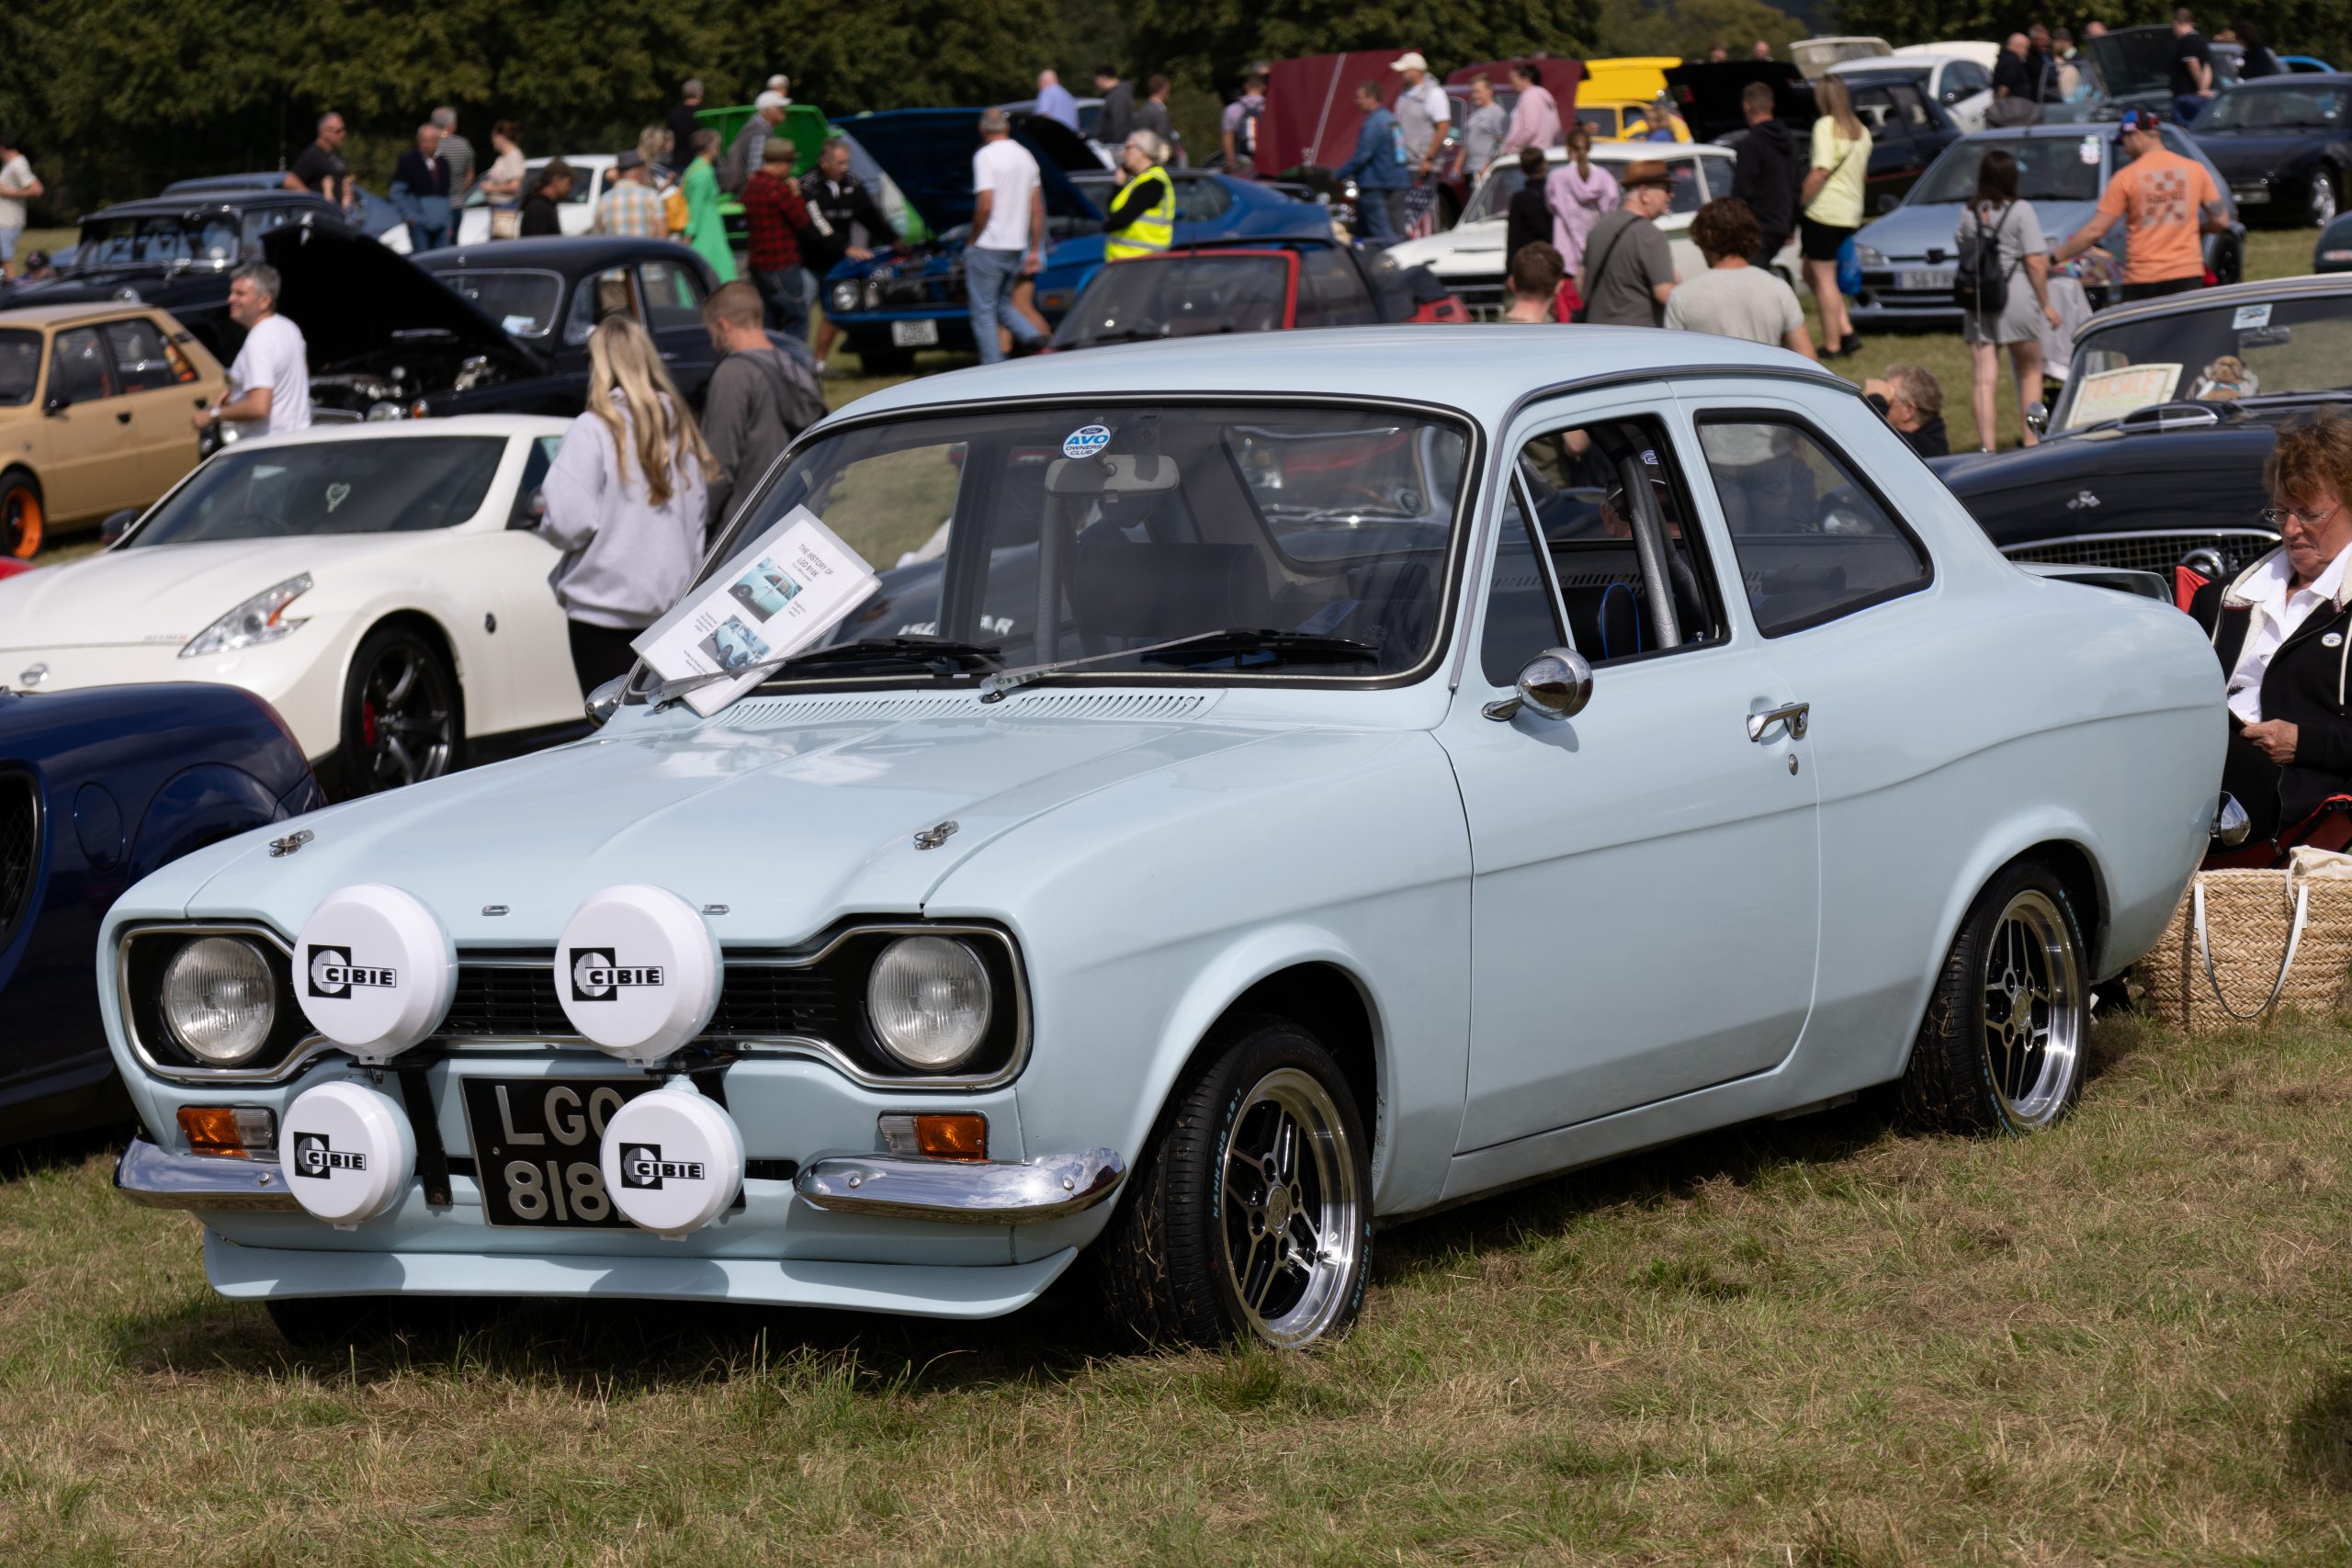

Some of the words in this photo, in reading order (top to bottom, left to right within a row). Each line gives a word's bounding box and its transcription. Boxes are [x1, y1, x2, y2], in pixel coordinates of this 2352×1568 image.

[1066, 434, 1109, 446] AVO
[797, 557, 808, 568] LGO
[798, 544, 809, 555] THE
[807, 551, 828, 570] HISTORY
[504, 1160, 630, 1222] 818
